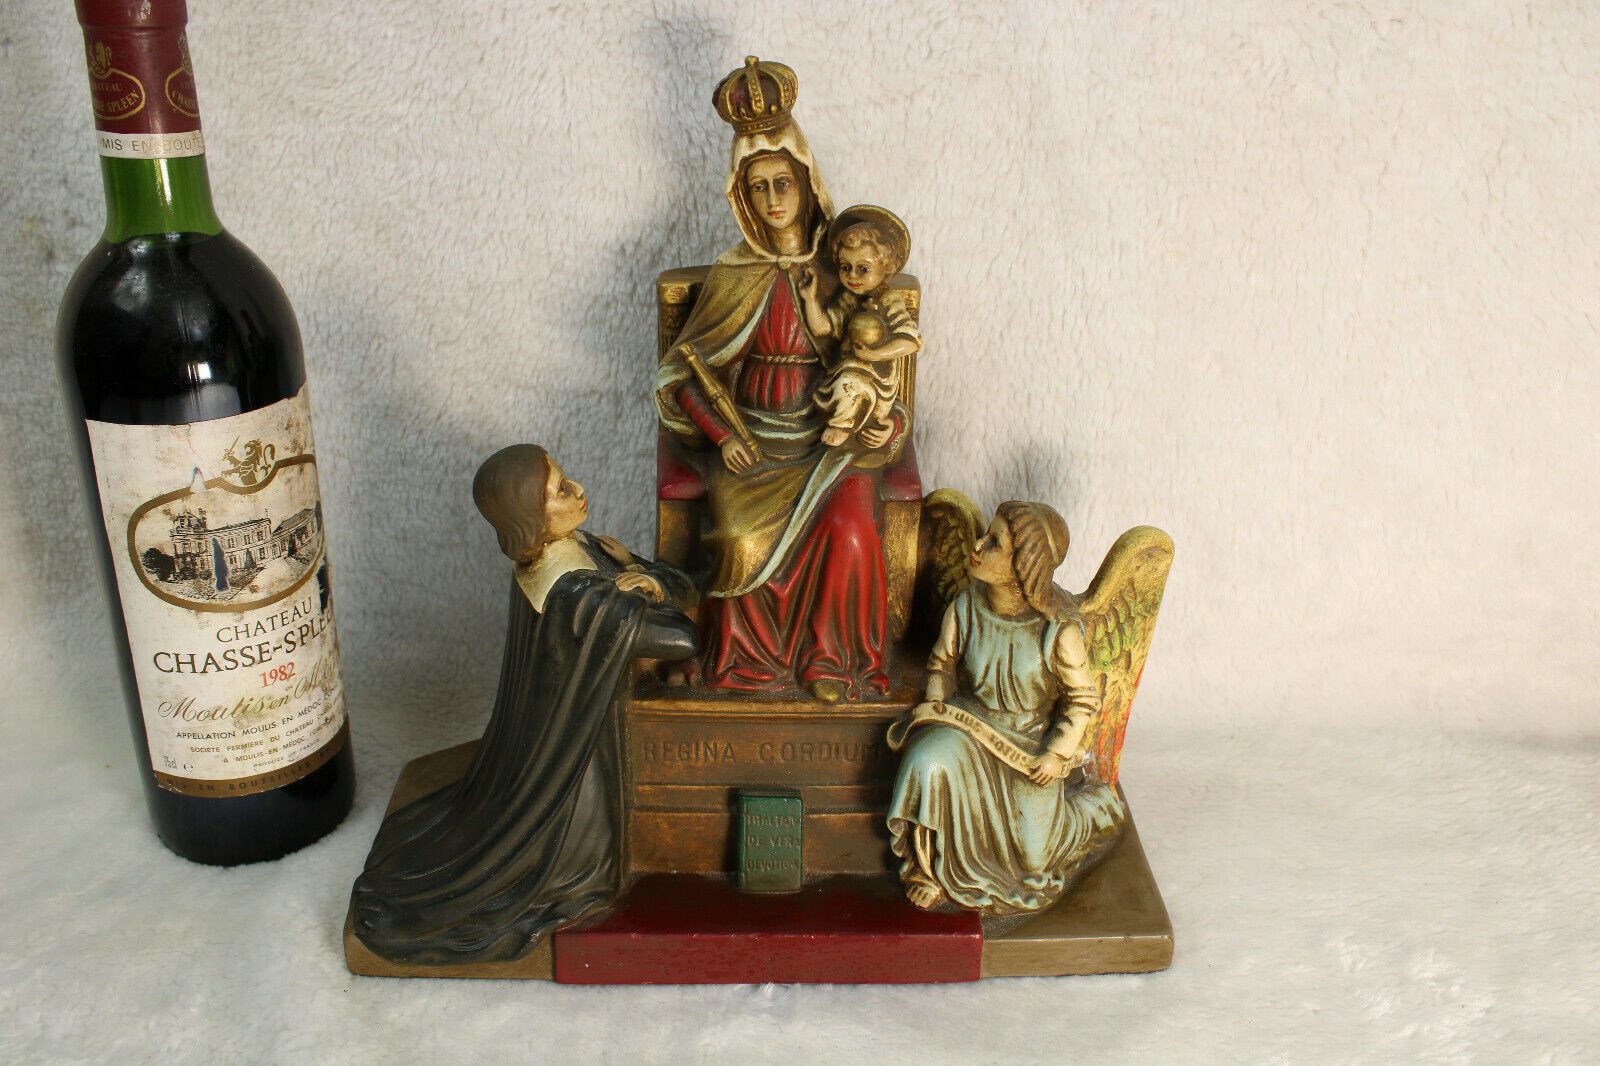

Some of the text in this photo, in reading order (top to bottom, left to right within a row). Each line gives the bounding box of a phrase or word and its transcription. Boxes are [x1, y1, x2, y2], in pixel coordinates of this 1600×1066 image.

[101, 138, 123, 151] MIS
[132, 140, 152, 153] EN
[216, 597, 312, 643] CHATEAU
[259, 662, 296, 688] 1982
[157, 697, 265, 722] Moulis
[176, 731, 236, 740] APPELLATION
[242, 721, 276, 736] MOULIS
[282, 714, 294, 725] EN
[270, 734, 281, 743] DU
[286, 719, 315, 737] CHATEAU
[642, 741, 880, 764] REGINA CORDIUM
